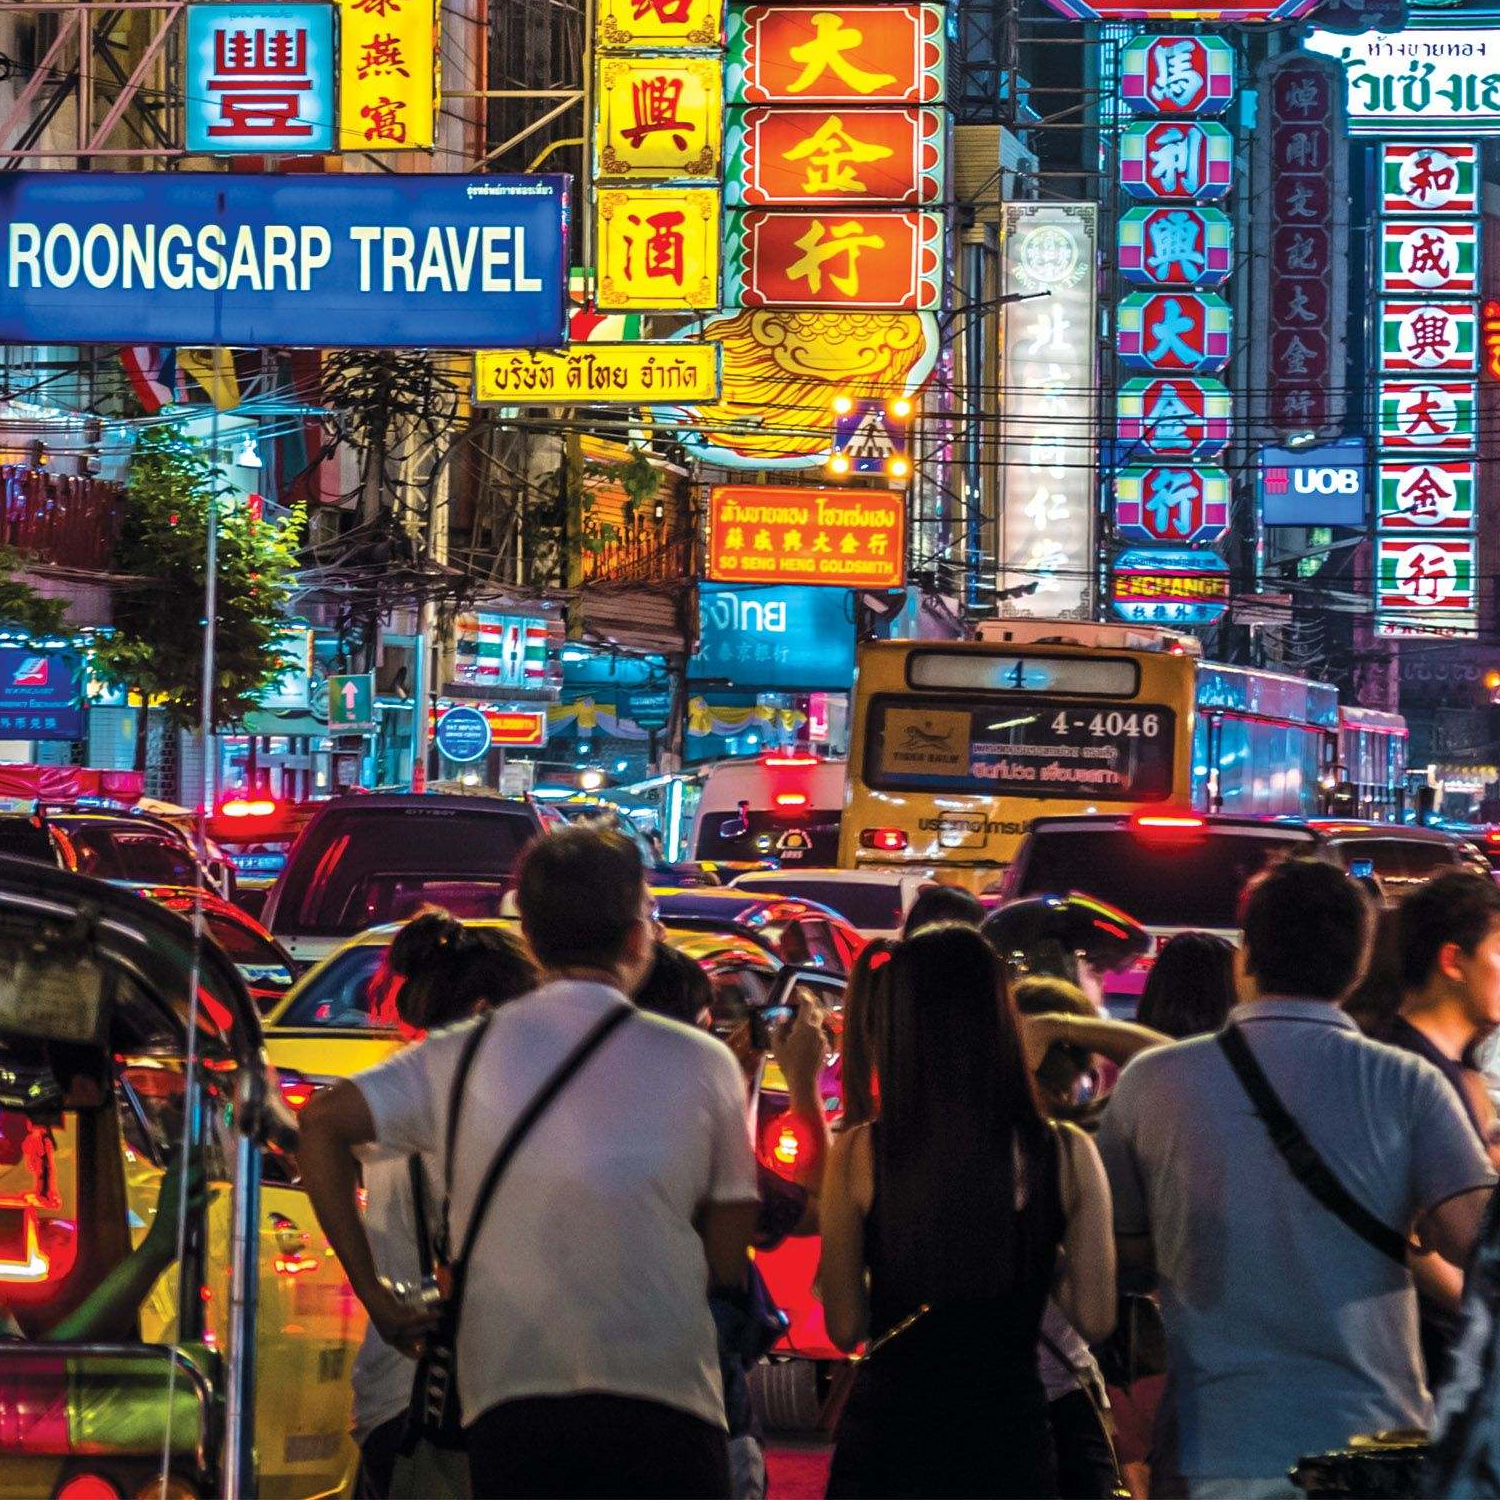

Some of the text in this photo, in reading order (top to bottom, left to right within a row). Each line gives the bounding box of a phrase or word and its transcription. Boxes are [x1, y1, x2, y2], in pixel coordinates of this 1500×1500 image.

[7, 223, 543, 293] ROONGSARP TRAVEL
[494, 359, 555, 391] บริษัท
[640, 357, 698, 389] จำกัด
[1294, 468, 1359, 494] UOB
[719, 556, 894, 574] SO SENG HENG GOLDSMITH
[1007, 659, 1027, 689] 4
[1051, 711, 1159, 738] 4-4046
